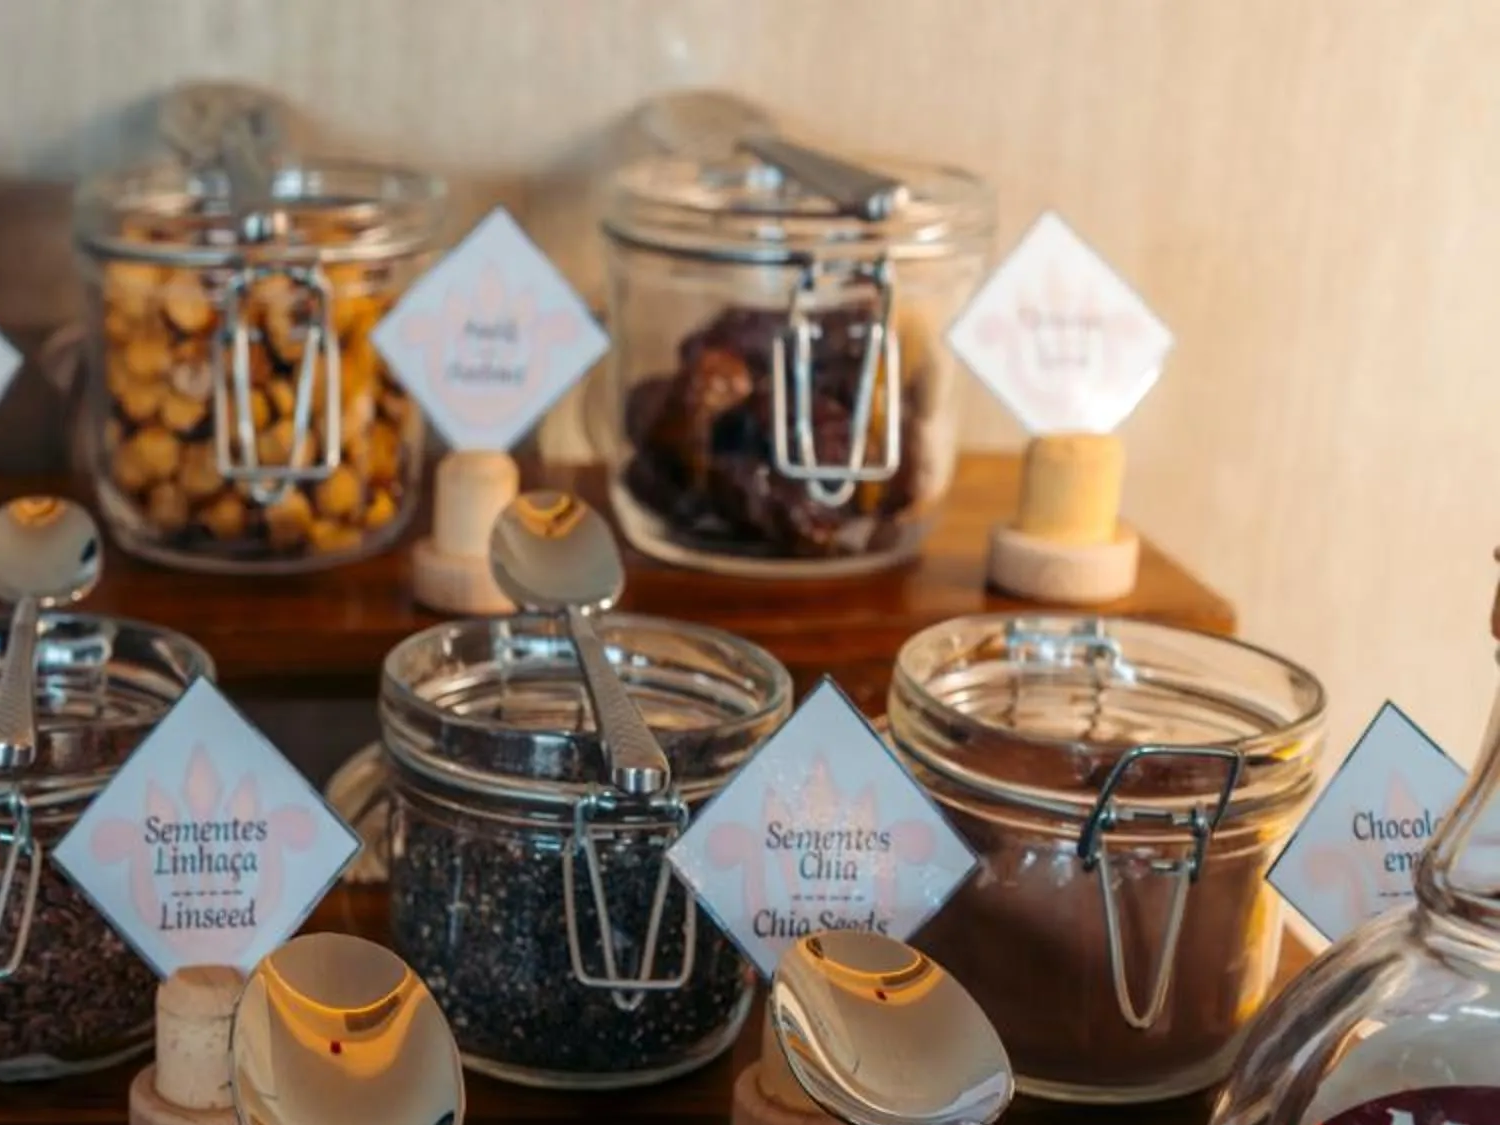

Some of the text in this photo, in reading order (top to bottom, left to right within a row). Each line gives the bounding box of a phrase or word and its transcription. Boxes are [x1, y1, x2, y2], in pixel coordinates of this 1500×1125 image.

[144, 816, 268, 845] Sementes
[765, 820, 891, 852] Sementes
[154, 845, 258, 881] Linhaça
[799, 852, 859, 882] Chia
[160, 898, 257, 931] Linseed
[752, 908, 811, 939] Chia
